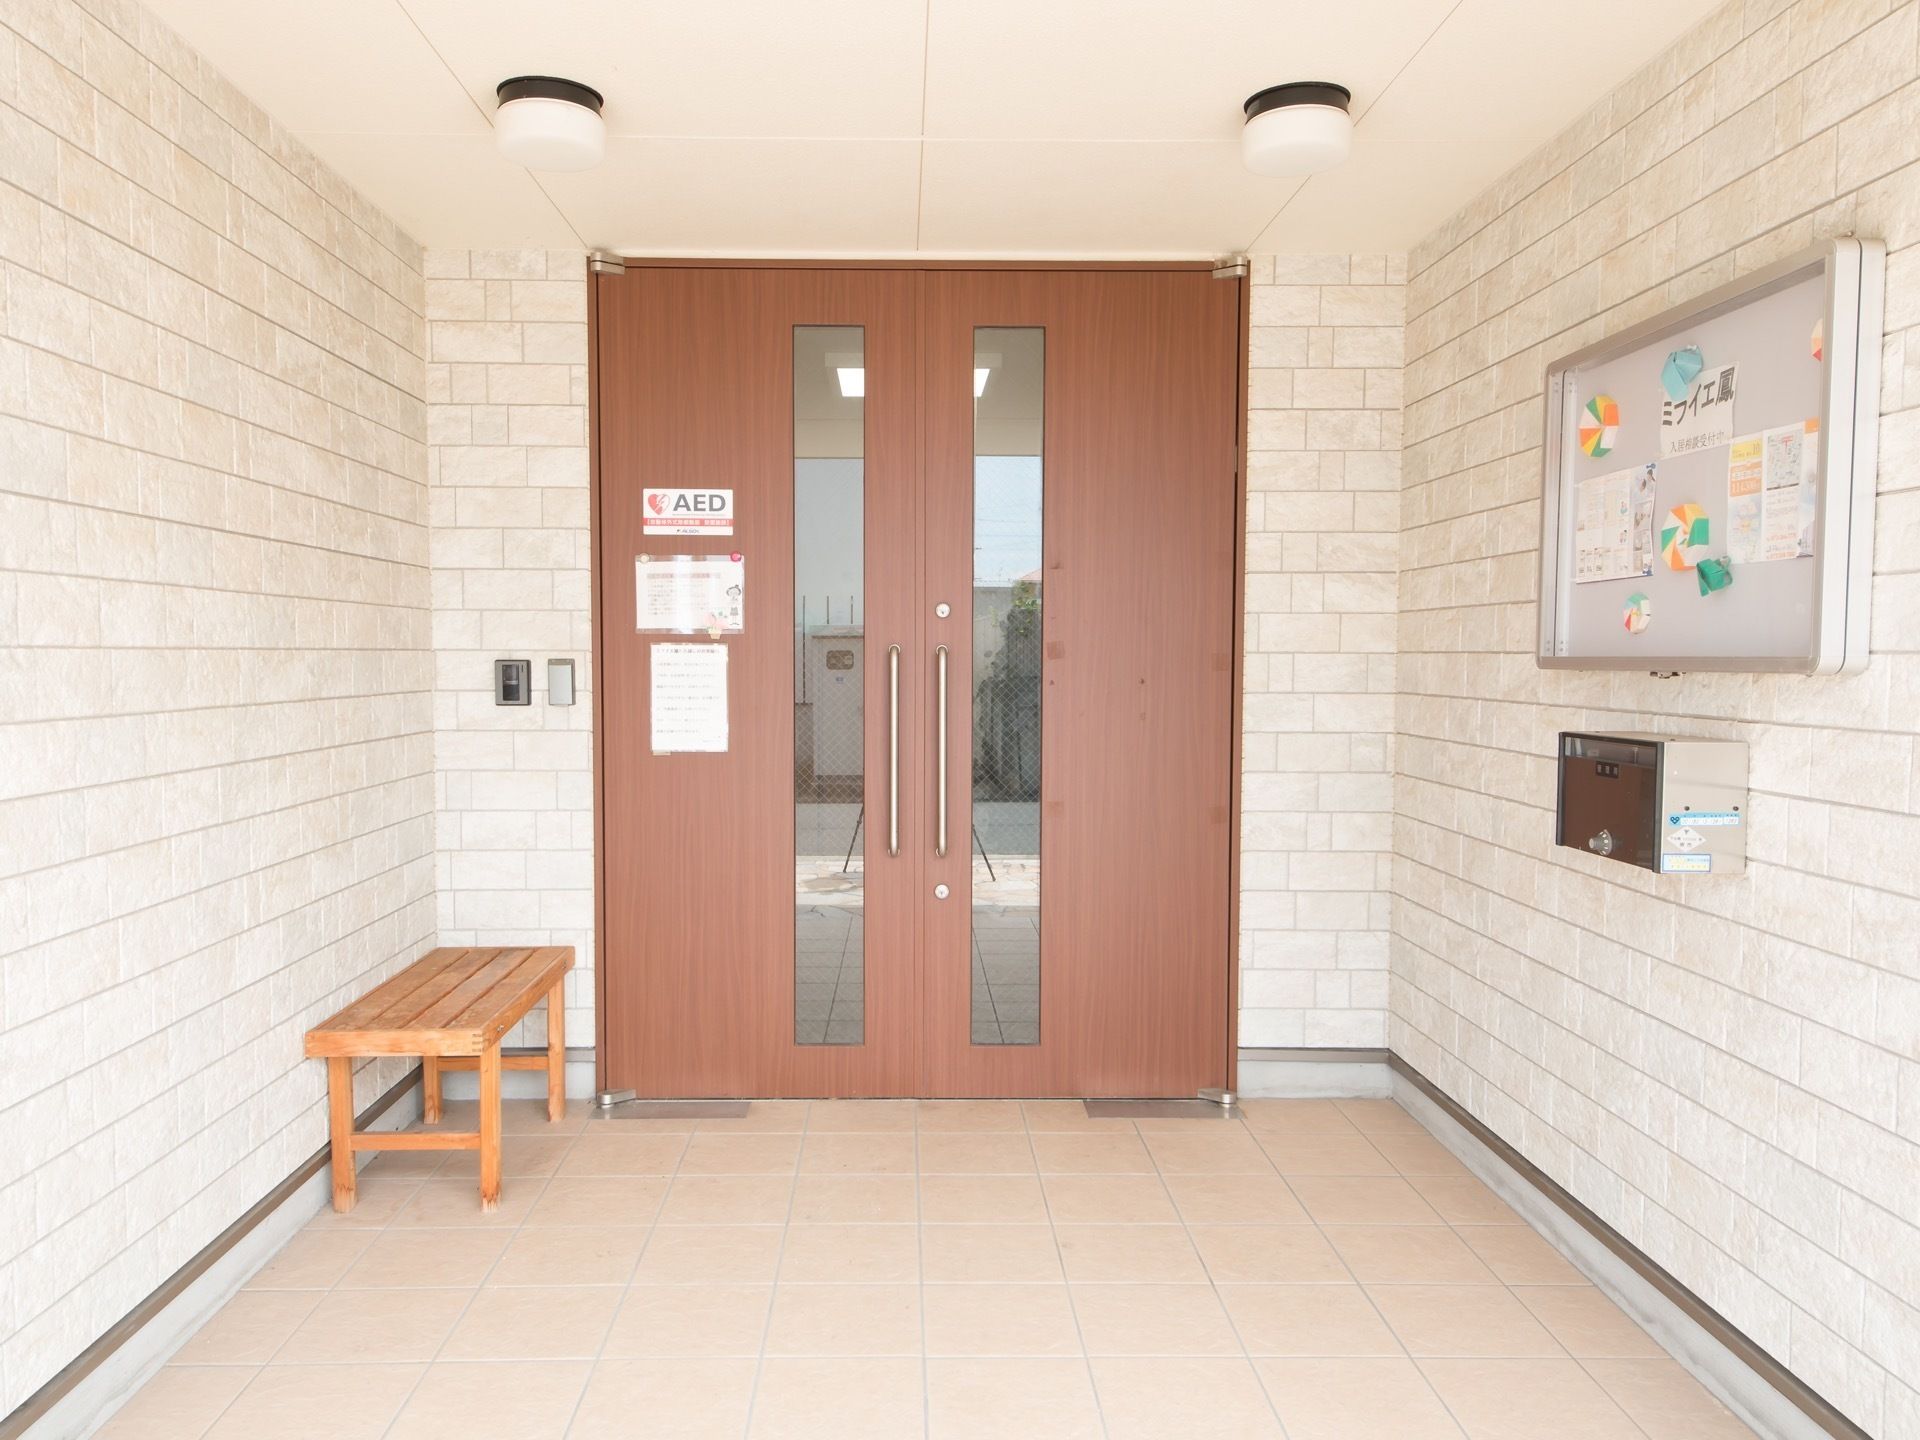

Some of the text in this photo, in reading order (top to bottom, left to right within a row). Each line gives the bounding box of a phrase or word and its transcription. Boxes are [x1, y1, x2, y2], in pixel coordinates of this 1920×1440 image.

[1671, 431, 1725, 453] 入居相談受付中
[673, 494, 726, 512] AED
